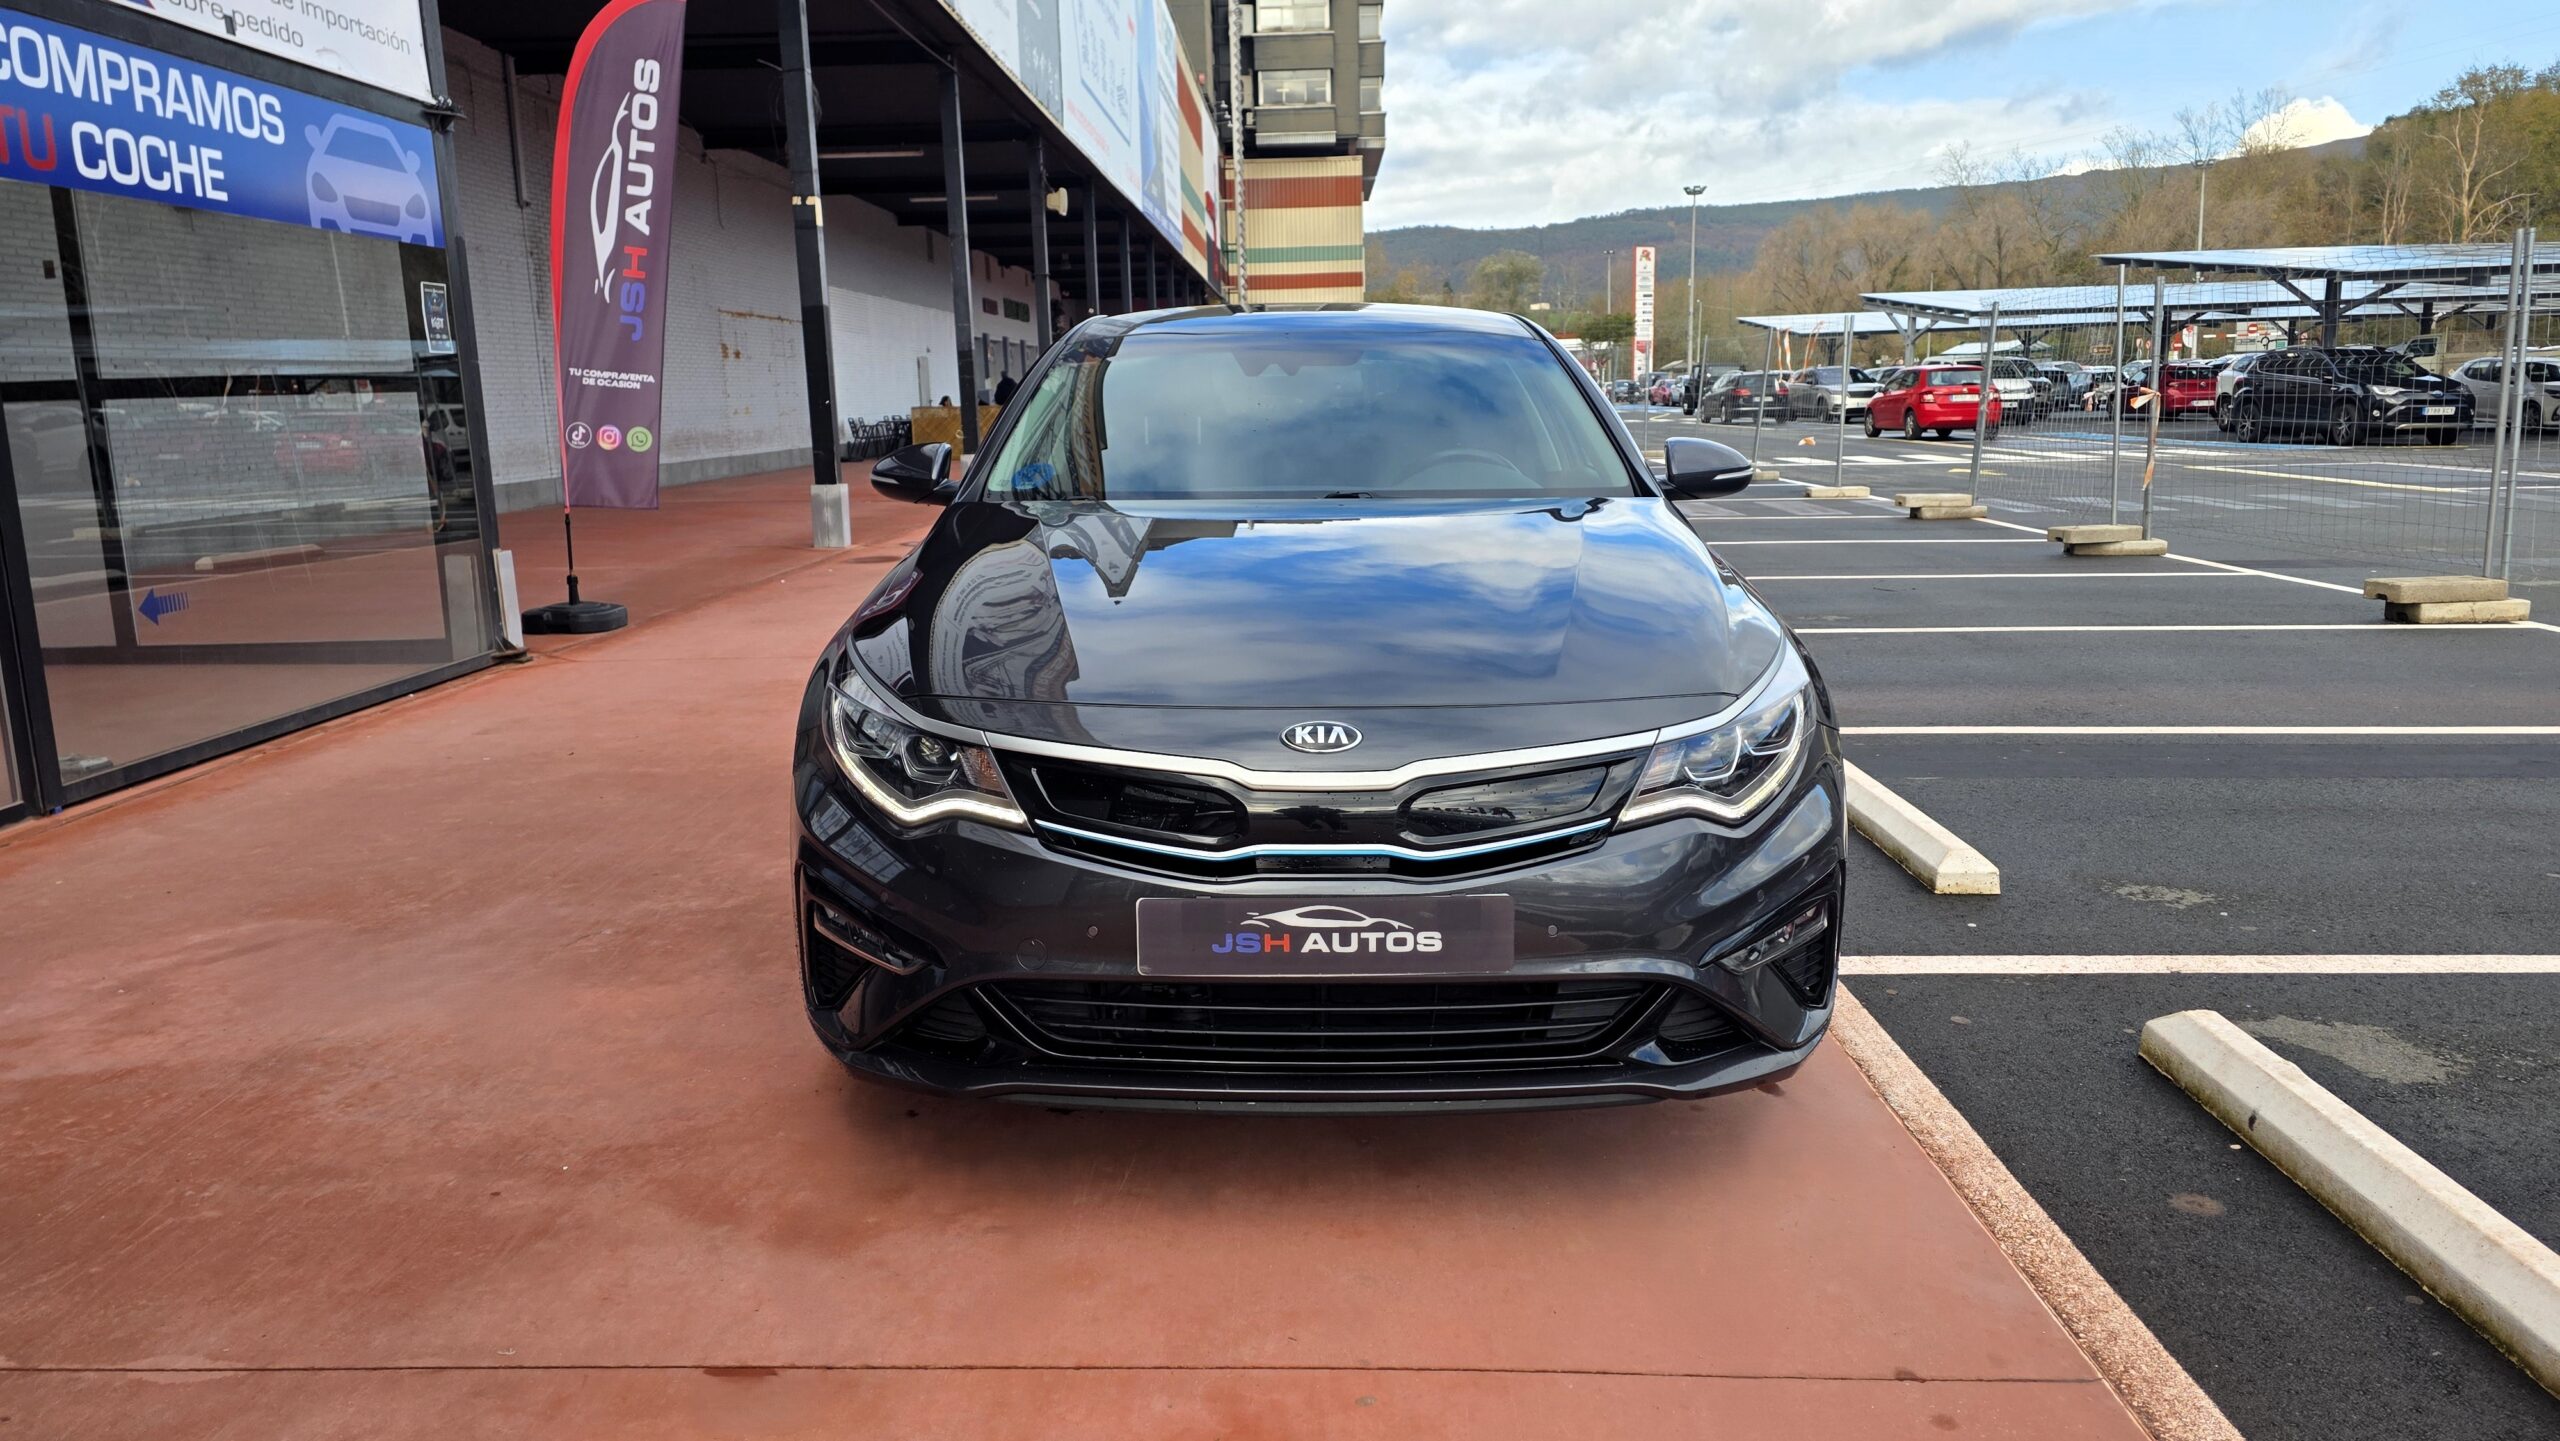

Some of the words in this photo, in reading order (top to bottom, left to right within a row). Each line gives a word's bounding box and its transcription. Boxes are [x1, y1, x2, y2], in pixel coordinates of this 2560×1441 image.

[232, 9, 304, 48] pedido
[72, 121, 229, 202] COCHE
[625, 58, 661, 236] AUTOS
[619, 245, 648, 342] JSH
[569, 368, 582, 376] TU
[583, 369, 655, 383] COMPRAVENTA
[582, 377, 596, 386] DE
[1294, 725, 1349, 745] KIA
[1212, 932, 1290, 954] JSH
[1301, 932, 1442, 953] AUTOS
